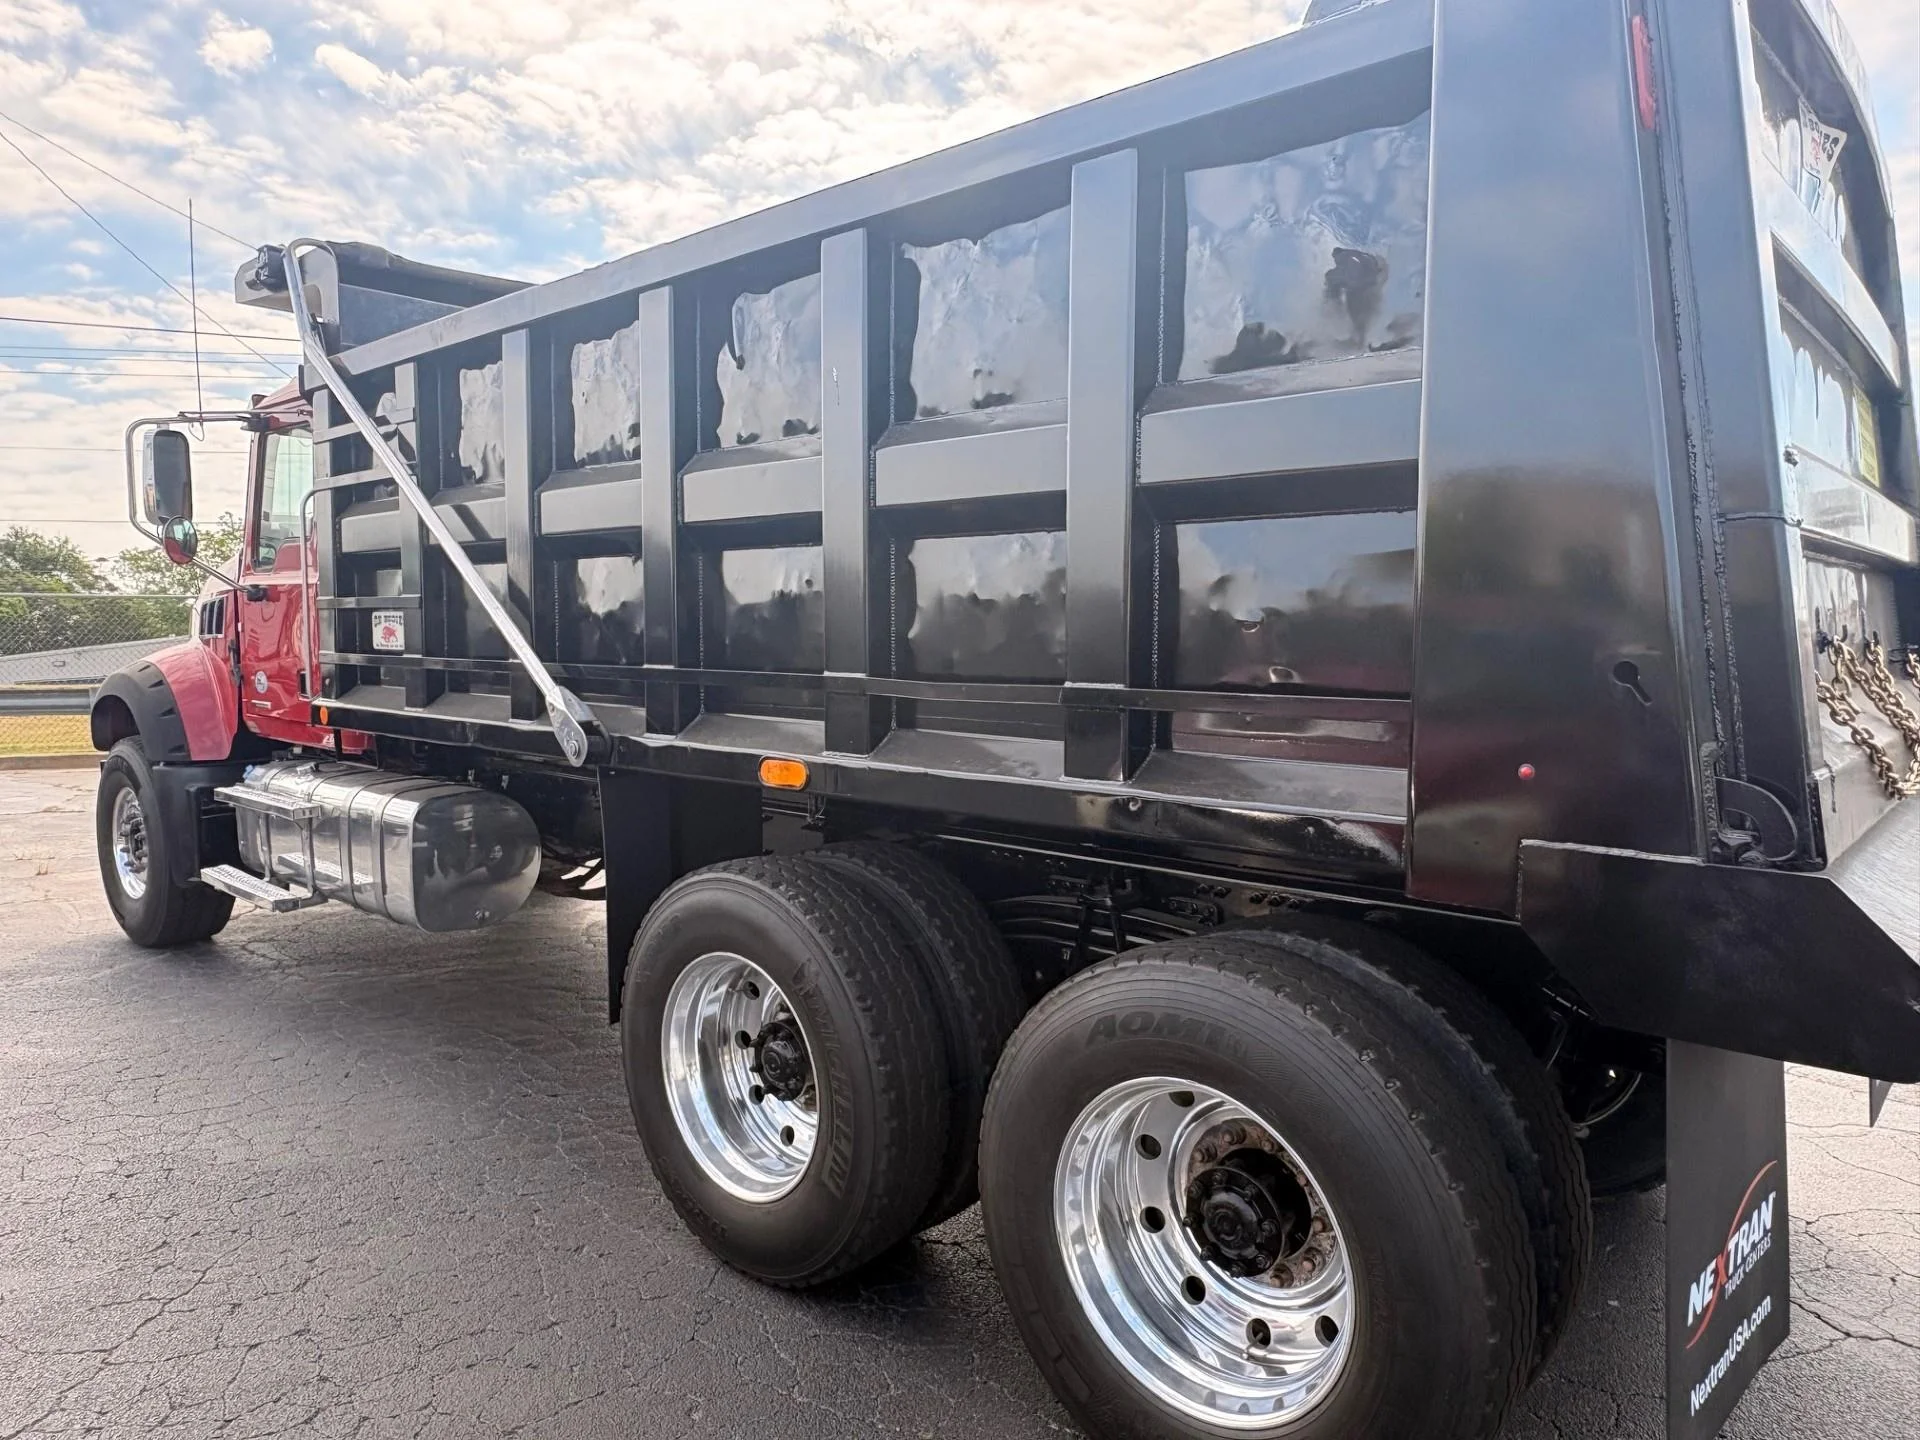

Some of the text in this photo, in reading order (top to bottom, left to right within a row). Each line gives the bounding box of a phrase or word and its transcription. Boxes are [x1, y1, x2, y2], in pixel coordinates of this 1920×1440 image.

[1687, 1192, 1775, 1327] NEXTRAN
[1724, 1232, 1772, 1300] TRUCK CENTERS
[1690, 1295, 1772, 1417] NextranUSA.com
